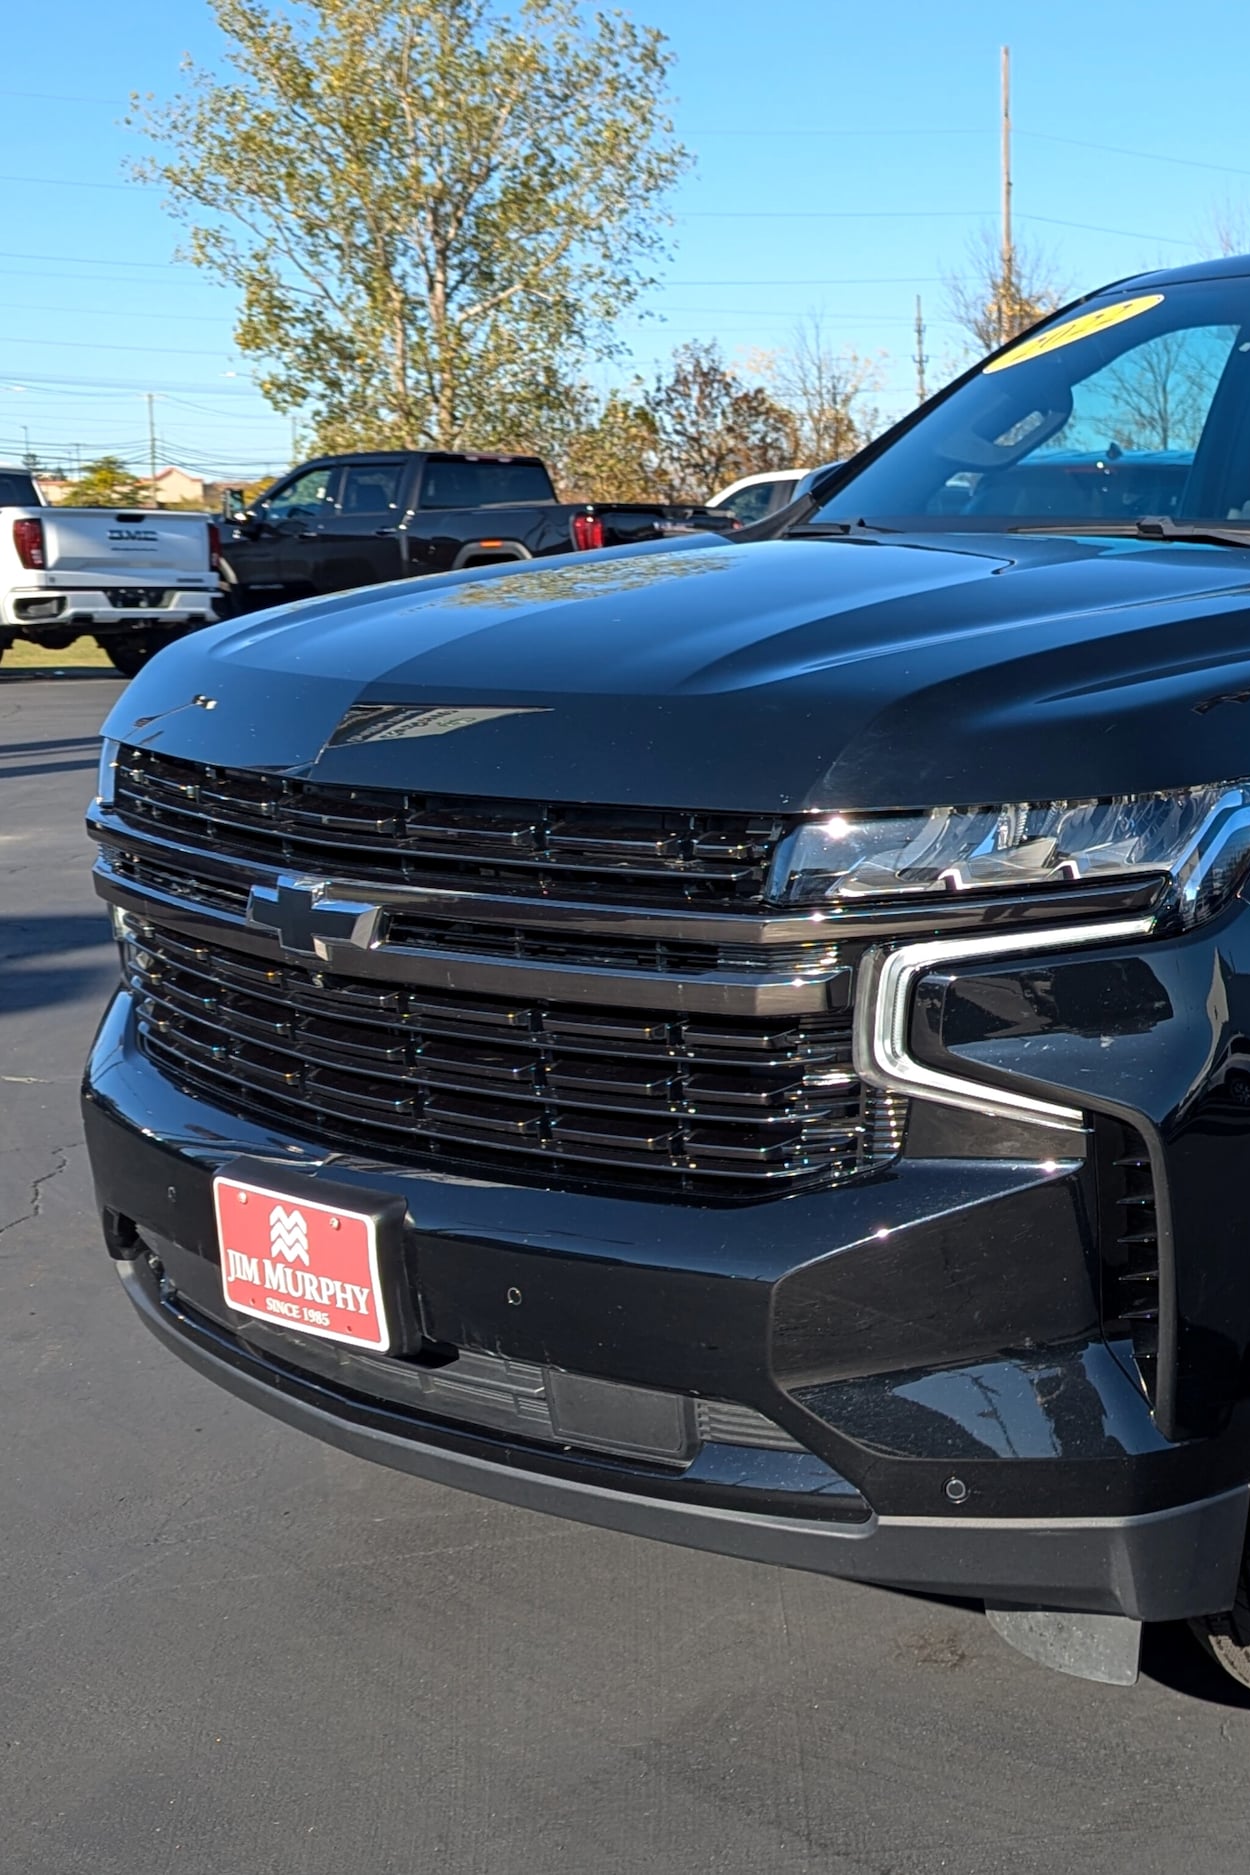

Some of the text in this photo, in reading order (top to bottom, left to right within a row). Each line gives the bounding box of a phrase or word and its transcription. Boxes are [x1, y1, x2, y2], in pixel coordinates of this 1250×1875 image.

[227, 1249, 370, 1315] JIM MURPHY
[265, 1297, 330, 1326] SINCE 1985
